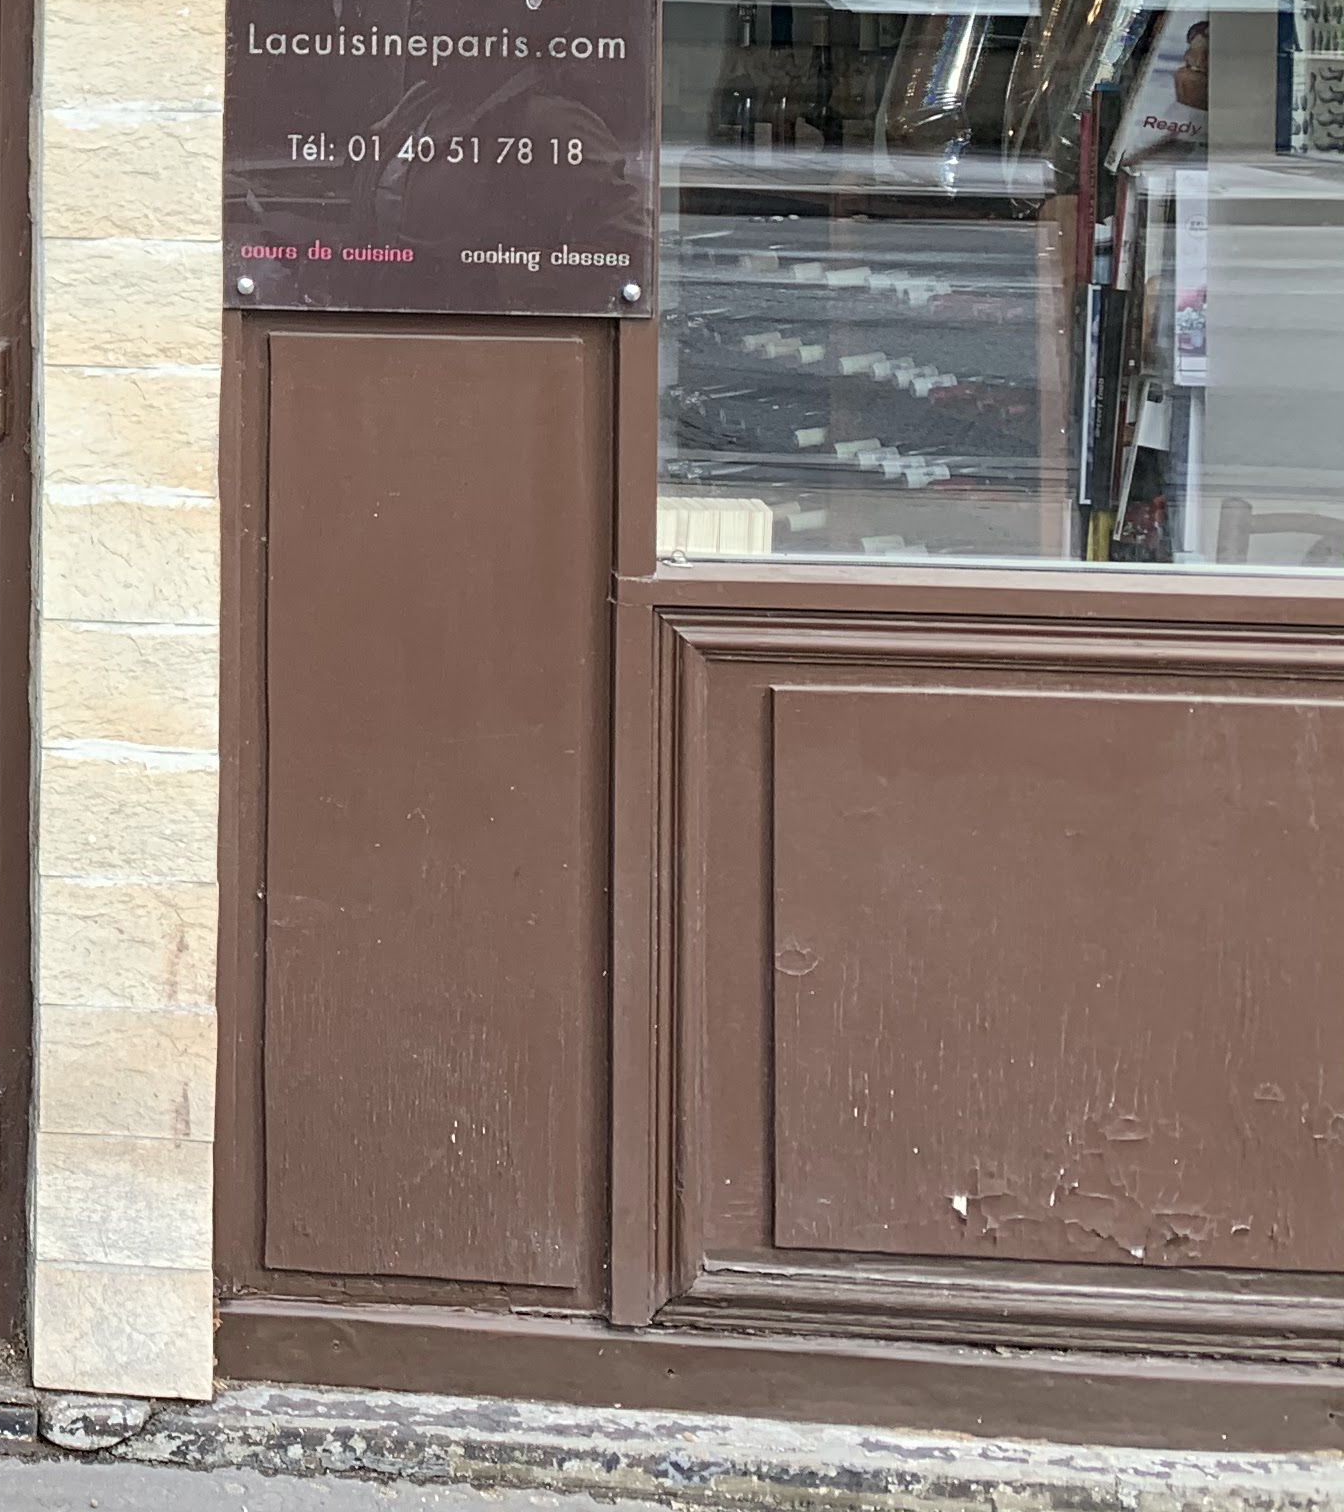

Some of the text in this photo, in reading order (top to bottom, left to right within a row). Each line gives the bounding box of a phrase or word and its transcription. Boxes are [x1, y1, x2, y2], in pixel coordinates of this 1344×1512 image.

[249, 24, 626, 64] Lacuisineparis.com
[1143, 115, 1202, 136] Ready
[287, 133, 583, 165] Tél: 01 40 51 78 18
[241, 242, 414, 263] cours de cuisine
[461, 243, 630, 272] cooking classes
